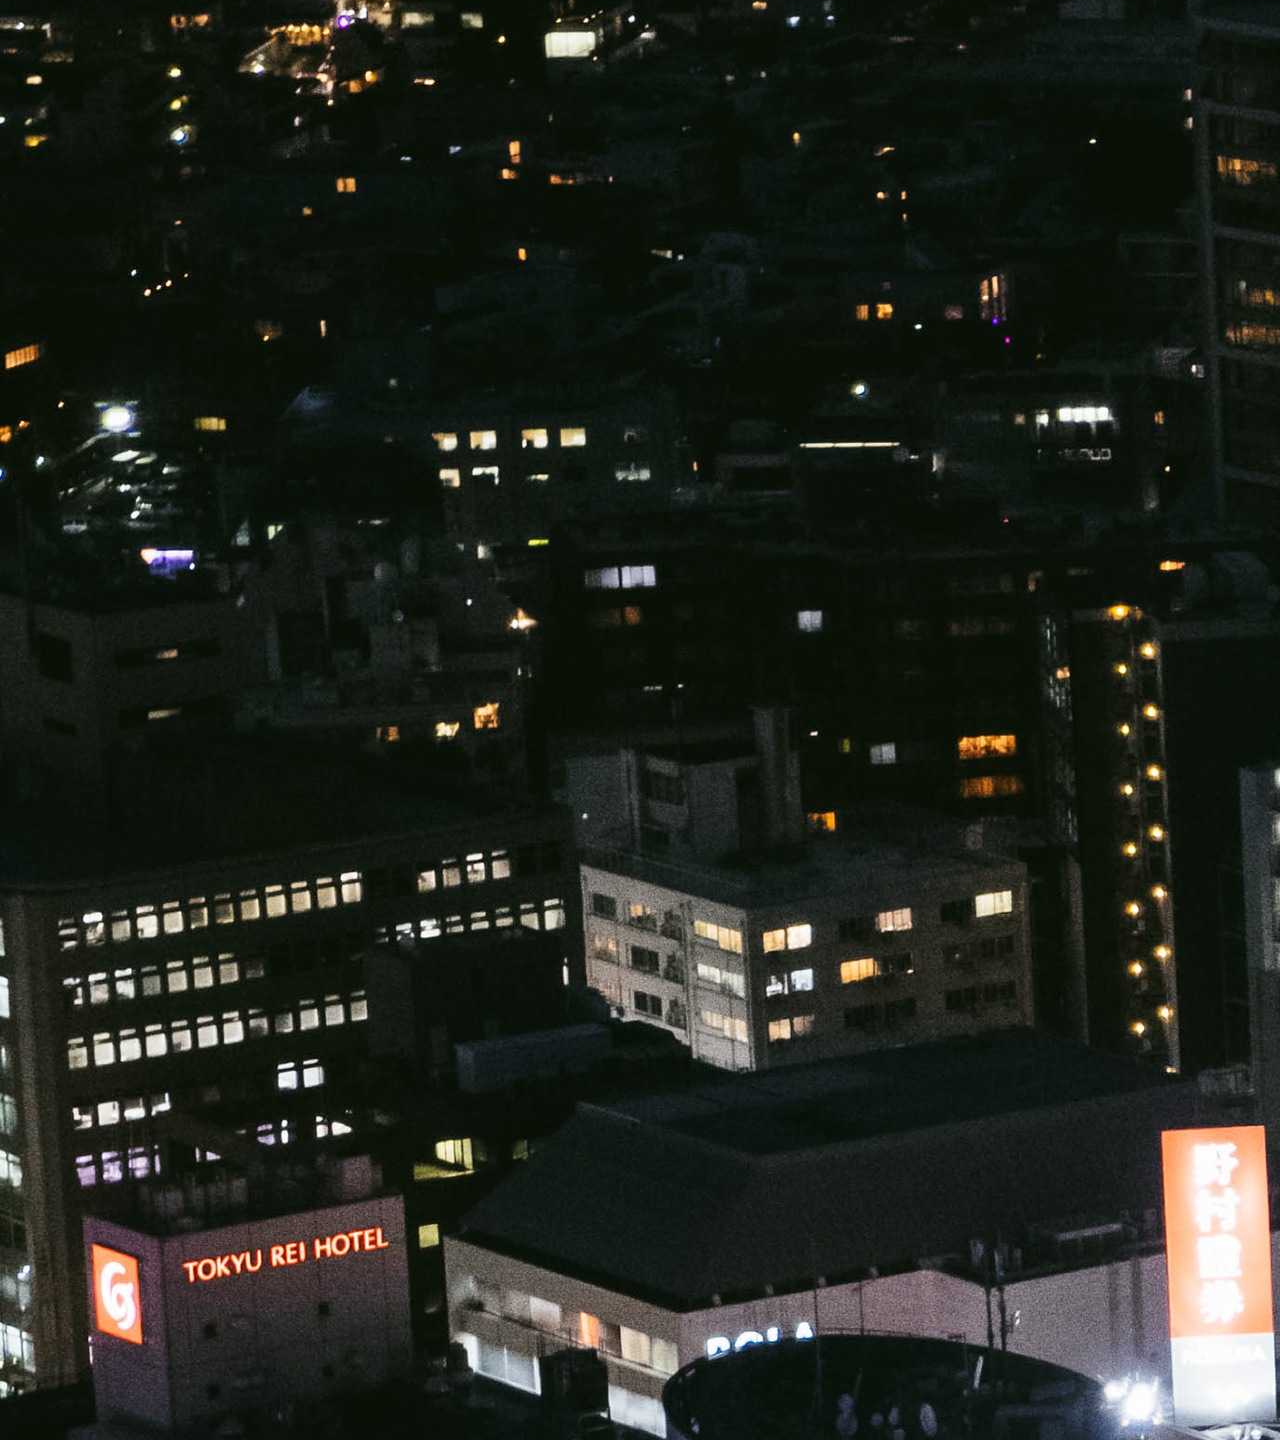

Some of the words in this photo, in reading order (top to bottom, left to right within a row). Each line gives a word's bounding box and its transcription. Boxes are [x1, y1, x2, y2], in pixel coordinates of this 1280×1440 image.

[183, 1249, 262, 1283] TOKYU
[270, 1241, 306, 1267] REI
[314, 1227, 389, 1259] HOTEL
